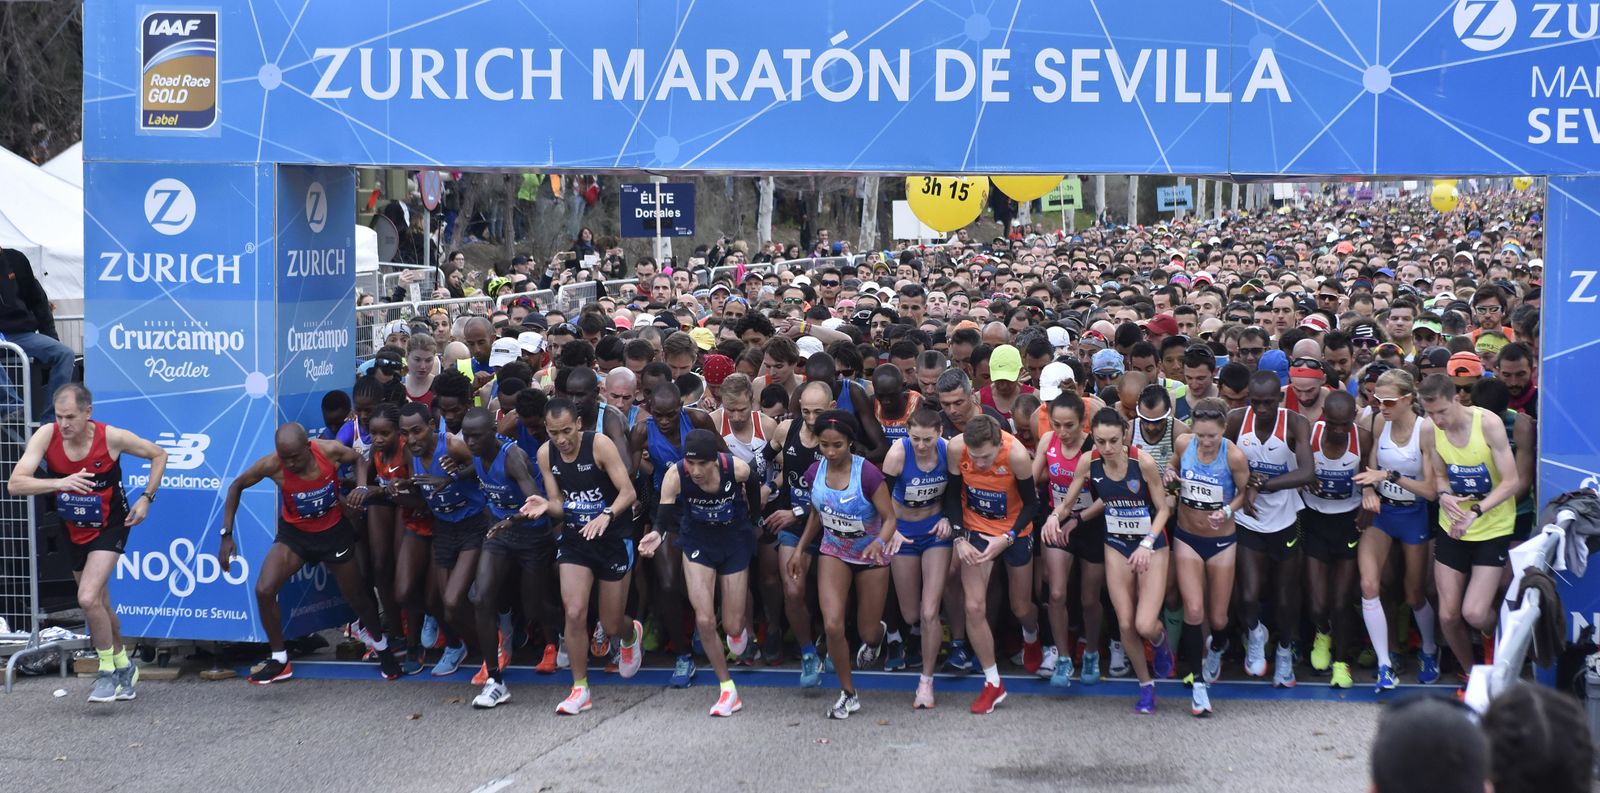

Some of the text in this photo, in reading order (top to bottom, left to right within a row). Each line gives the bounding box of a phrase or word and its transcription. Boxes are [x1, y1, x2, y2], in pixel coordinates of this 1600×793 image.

[148, 19, 201, 36] IAAF
[311, 30, 1292, 103] ZURICH MARATÓN DE SEVILLA
[150, 74, 210, 88] Road Race
[148, 89, 188, 104] GOLD
[148, 114, 178, 126] Label
[921, 176, 941, 196] 3h
[640, 190, 675, 204] ÉLTE
[98, 252, 241, 284] ZURICH
[287, 248, 346, 277] ZURICH
[109, 322, 245, 355] Cruzcampo
[287, 325, 349, 352] Cruzcampo
[144, 355, 210, 382] Radler
[303, 357, 335, 381] Radler
[1259, 463, 1286, 471] ZURICH
[163, 474, 220, 489] balance
[1327, 480, 1335, 489] 2
[570, 487, 603, 503] GAES
[1190, 485, 1212, 496] F103
[73, 506, 87, 515] 38
[979, 500, 991, 508] 94
[1118, 520, 1140, 528] F107
